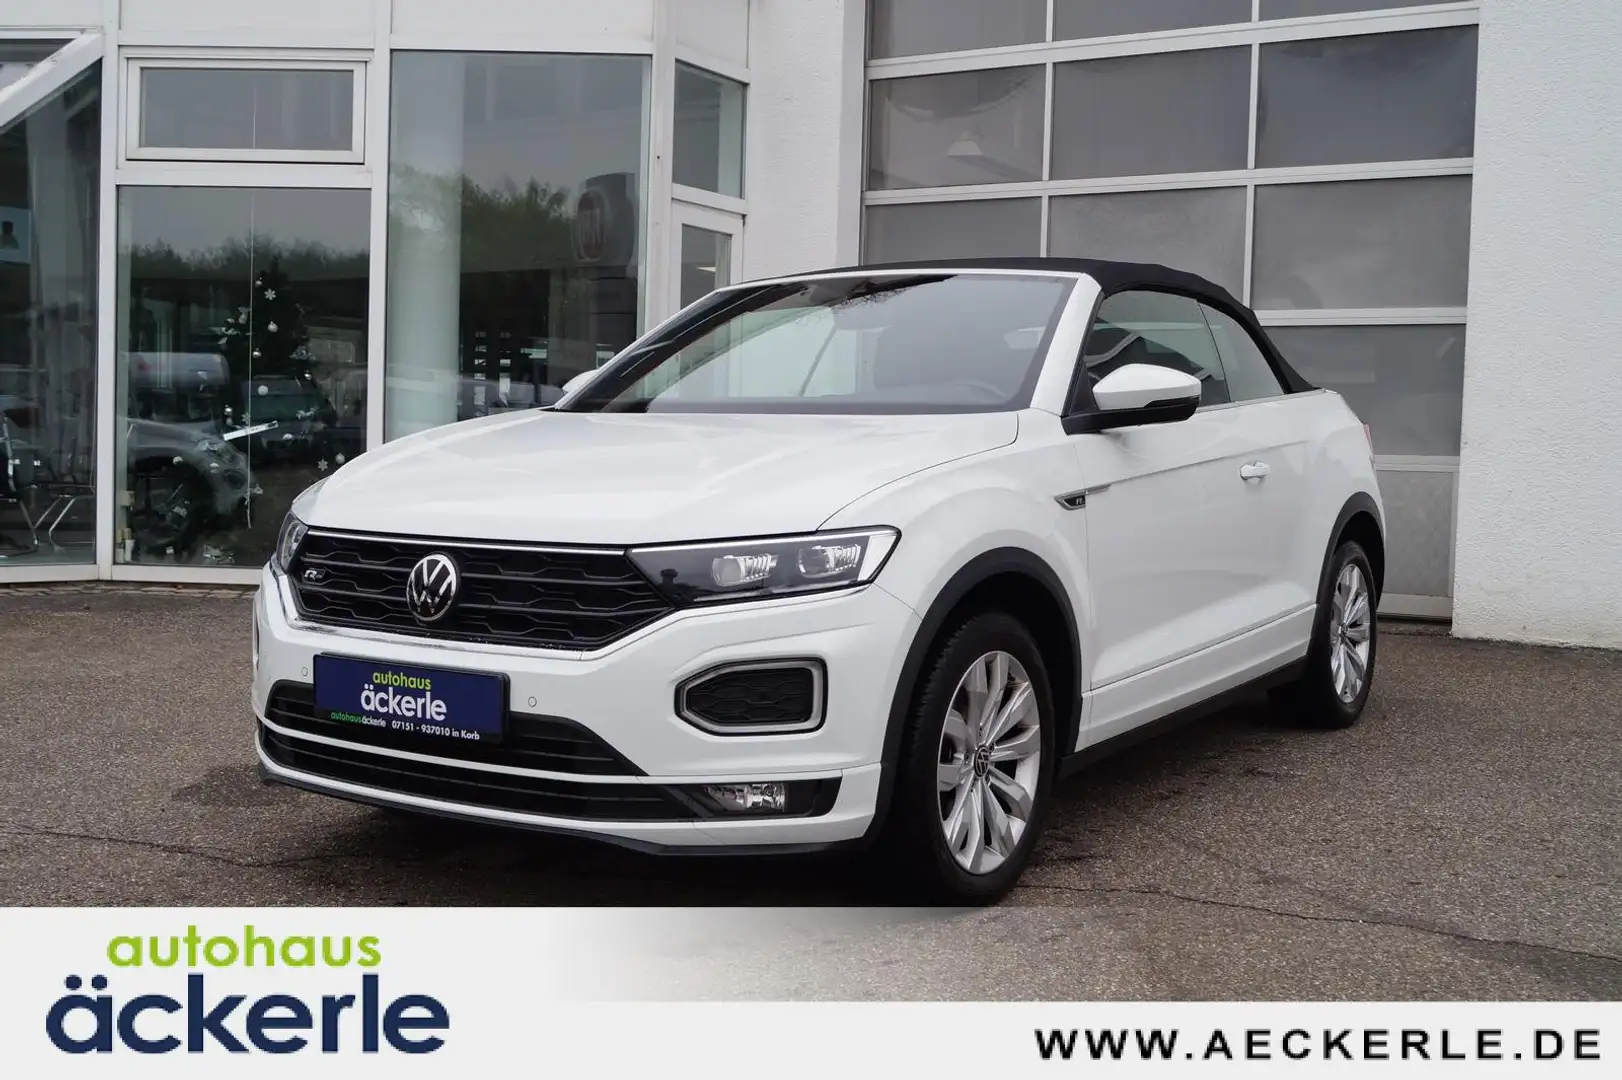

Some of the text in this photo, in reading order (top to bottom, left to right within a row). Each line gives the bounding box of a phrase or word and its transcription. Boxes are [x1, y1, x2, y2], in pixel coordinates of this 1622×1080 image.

[372, 670, 431, 690] autohaus
[360, 683, 447, 721] äckerle
[391, 720, 414, 731] 07151
[420, 724, 451, 736] 937010
[452, 728, 460, 737] in
[461, 730, 480, 740] Korb
